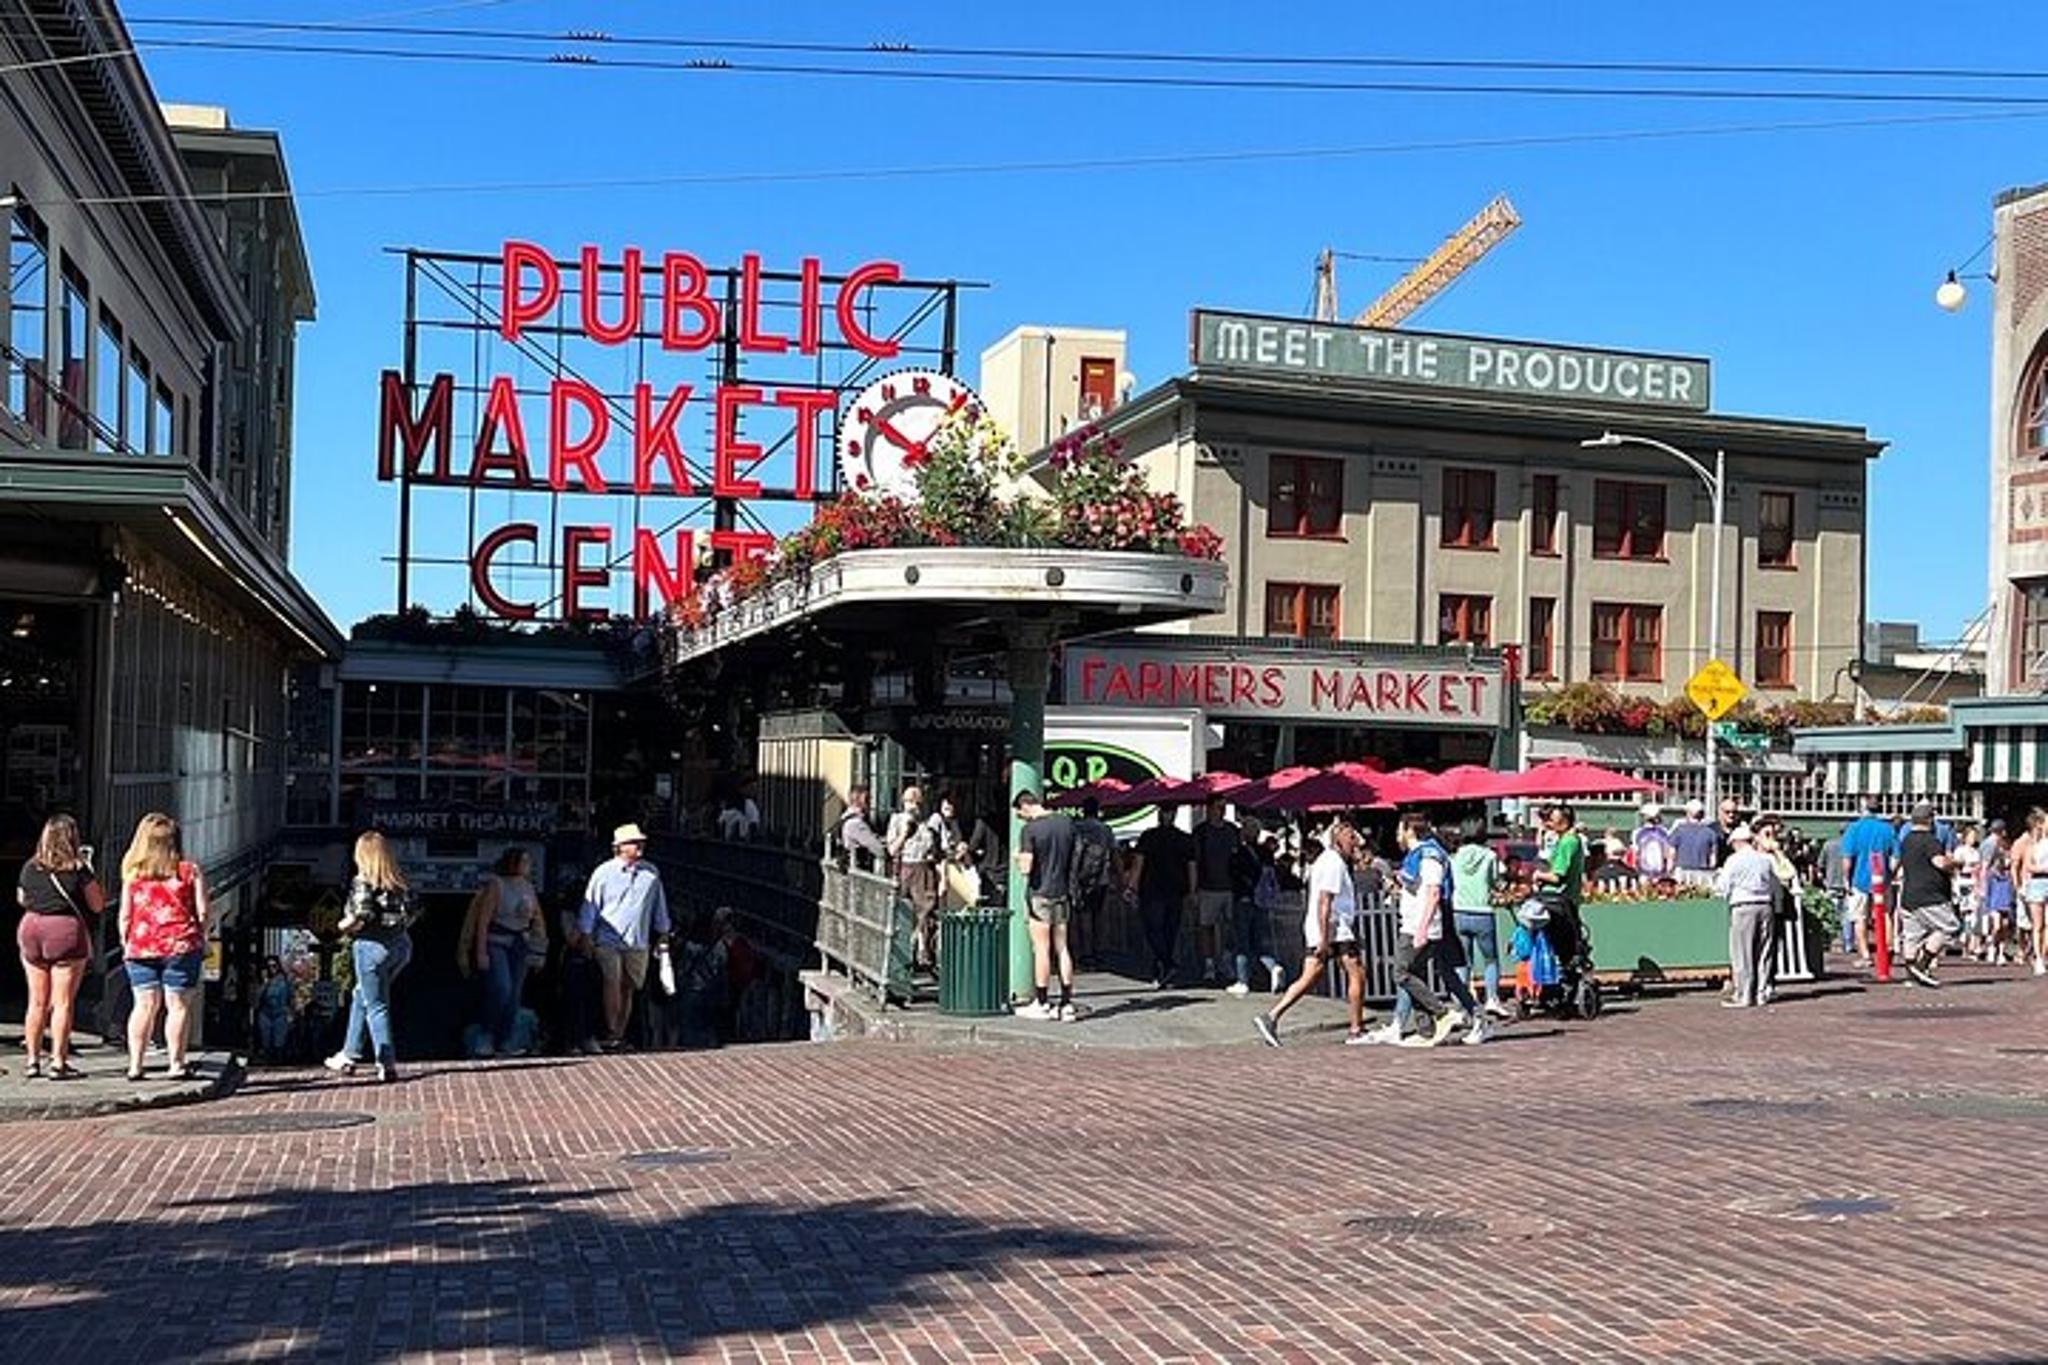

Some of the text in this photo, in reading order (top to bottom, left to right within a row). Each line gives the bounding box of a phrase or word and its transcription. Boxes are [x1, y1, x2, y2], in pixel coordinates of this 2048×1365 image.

[503, 241, 900, 358] PUBLIC
[1215, 319, 1695, 402] MEET THE PRODUCER
[377, 369, 838, 499] MARKET
[1081, 661, 1488, 718] FARMERS MARKET
[371, 811, 451, 831] MARKET
